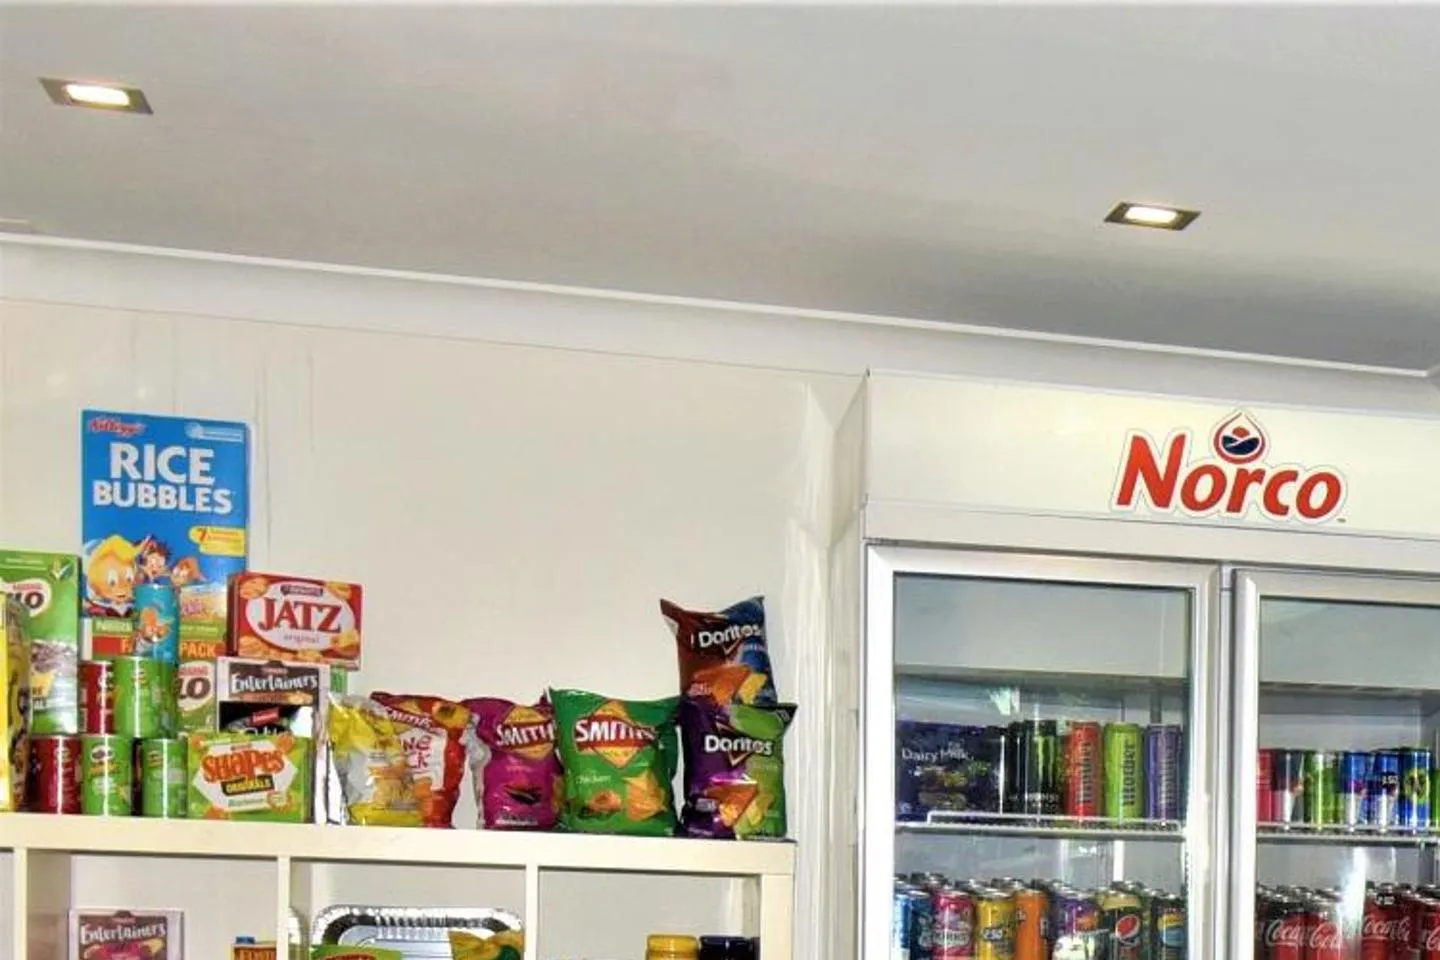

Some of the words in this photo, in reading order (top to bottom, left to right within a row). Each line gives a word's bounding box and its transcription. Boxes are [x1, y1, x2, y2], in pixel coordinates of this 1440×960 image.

[110, 442, 216, 486] RICE
[1115, 431, 1343, 520] Norco
[92, 480, 233, 515] BUBBLES
[257, 598, 345, 634] JATZ
[699, 622, 762, 649] Doritos
[704, 734, 774, 756] Doritos
